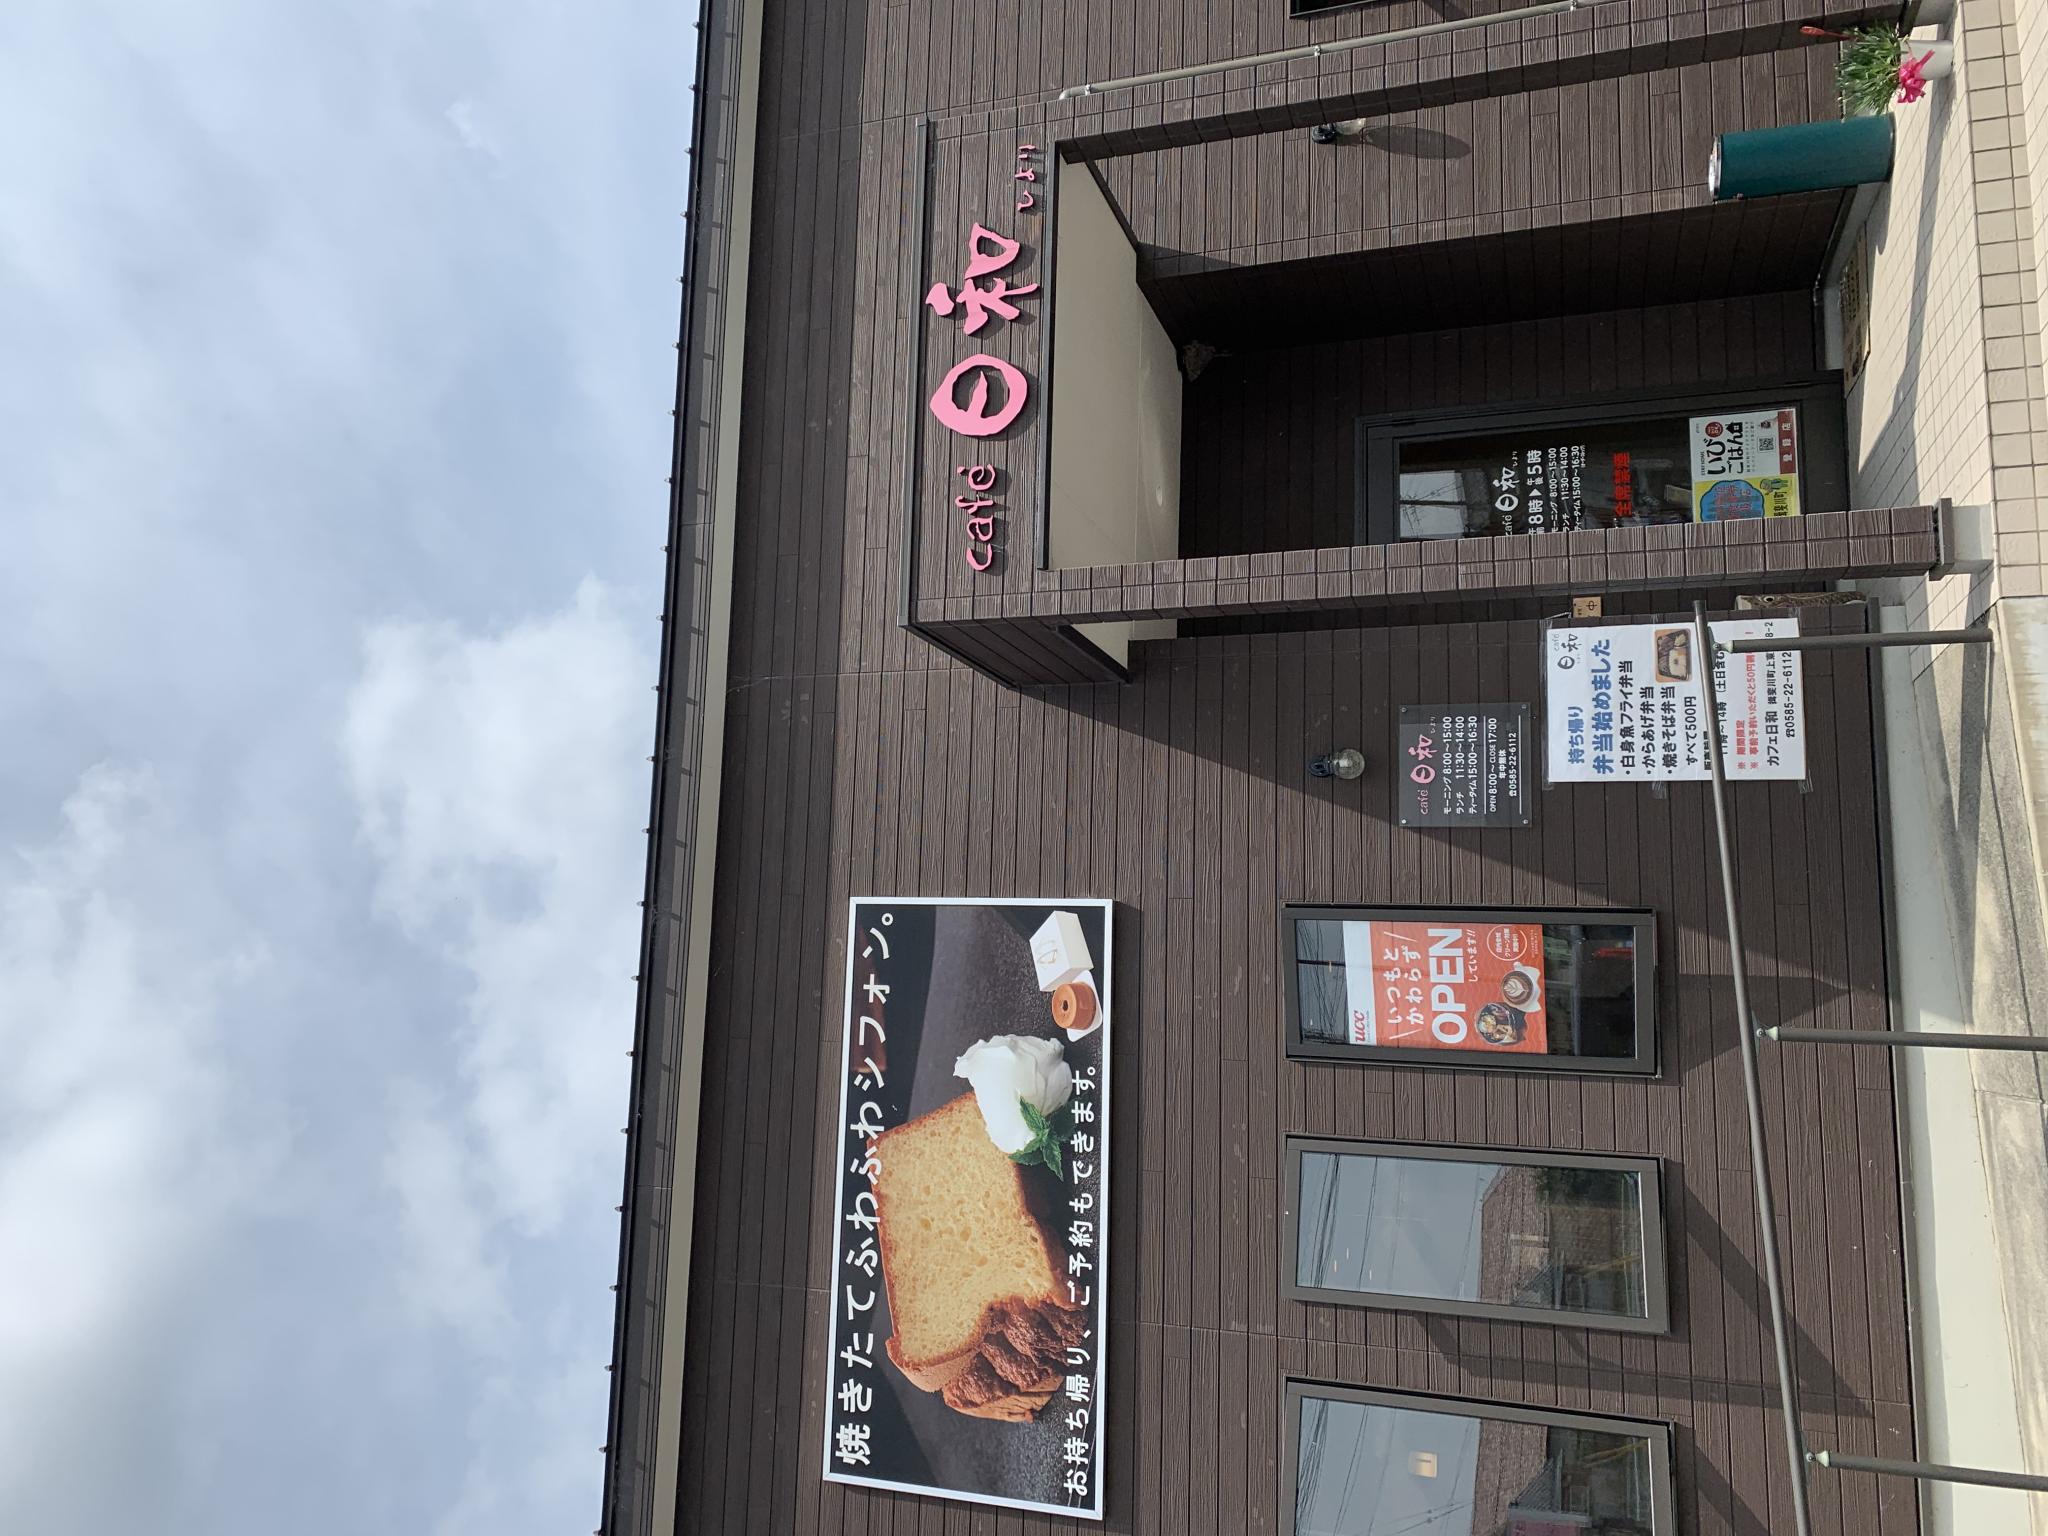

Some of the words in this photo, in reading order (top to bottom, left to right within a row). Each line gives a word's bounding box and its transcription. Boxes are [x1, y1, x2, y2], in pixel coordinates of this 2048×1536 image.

[1017, 145, 1036, 211] ひより
[925, 222, 1040, 436] 日和
[1703, 438, 1726, 475] いび
[1726, 432, 1744, 474] ごはん
[1492, 466, 1520, 512] 日和
[955, 464, 996, 571] café
[1550, 502, 1558, 533] モーニング
[1562, 513, 1570, 532] ランチ
[1557, 633, 1582, 670] 日和
[1488, 718, 1497, 743] 17:00
[1590, 639, 1614, 774] 弁当始めました
[1684, 696, 1698, 766] すべて500円
[1408, 734, 1438, 784] 日和
[1568, 706, 1584, 764] 持ち帰り
[1765, 710, 1780, 766] カフェ日和
[1443, 776, 1452, 814] モーニング
[1456, 792, 1464, 814] ランチ
[1469, 780, 1478, 814] ティータイム
[1383, 947, 1402, 1024] いつもと
[1401, 946, 1424, 1025] かわらず
[1428, 928, 1468, 1044] OPEN
[835, 911, 894, 1465] 焼きたてふわふわシフォン。
[1063, 1065, 1097, 1497] お持ち帰り、ご予約もできます。
